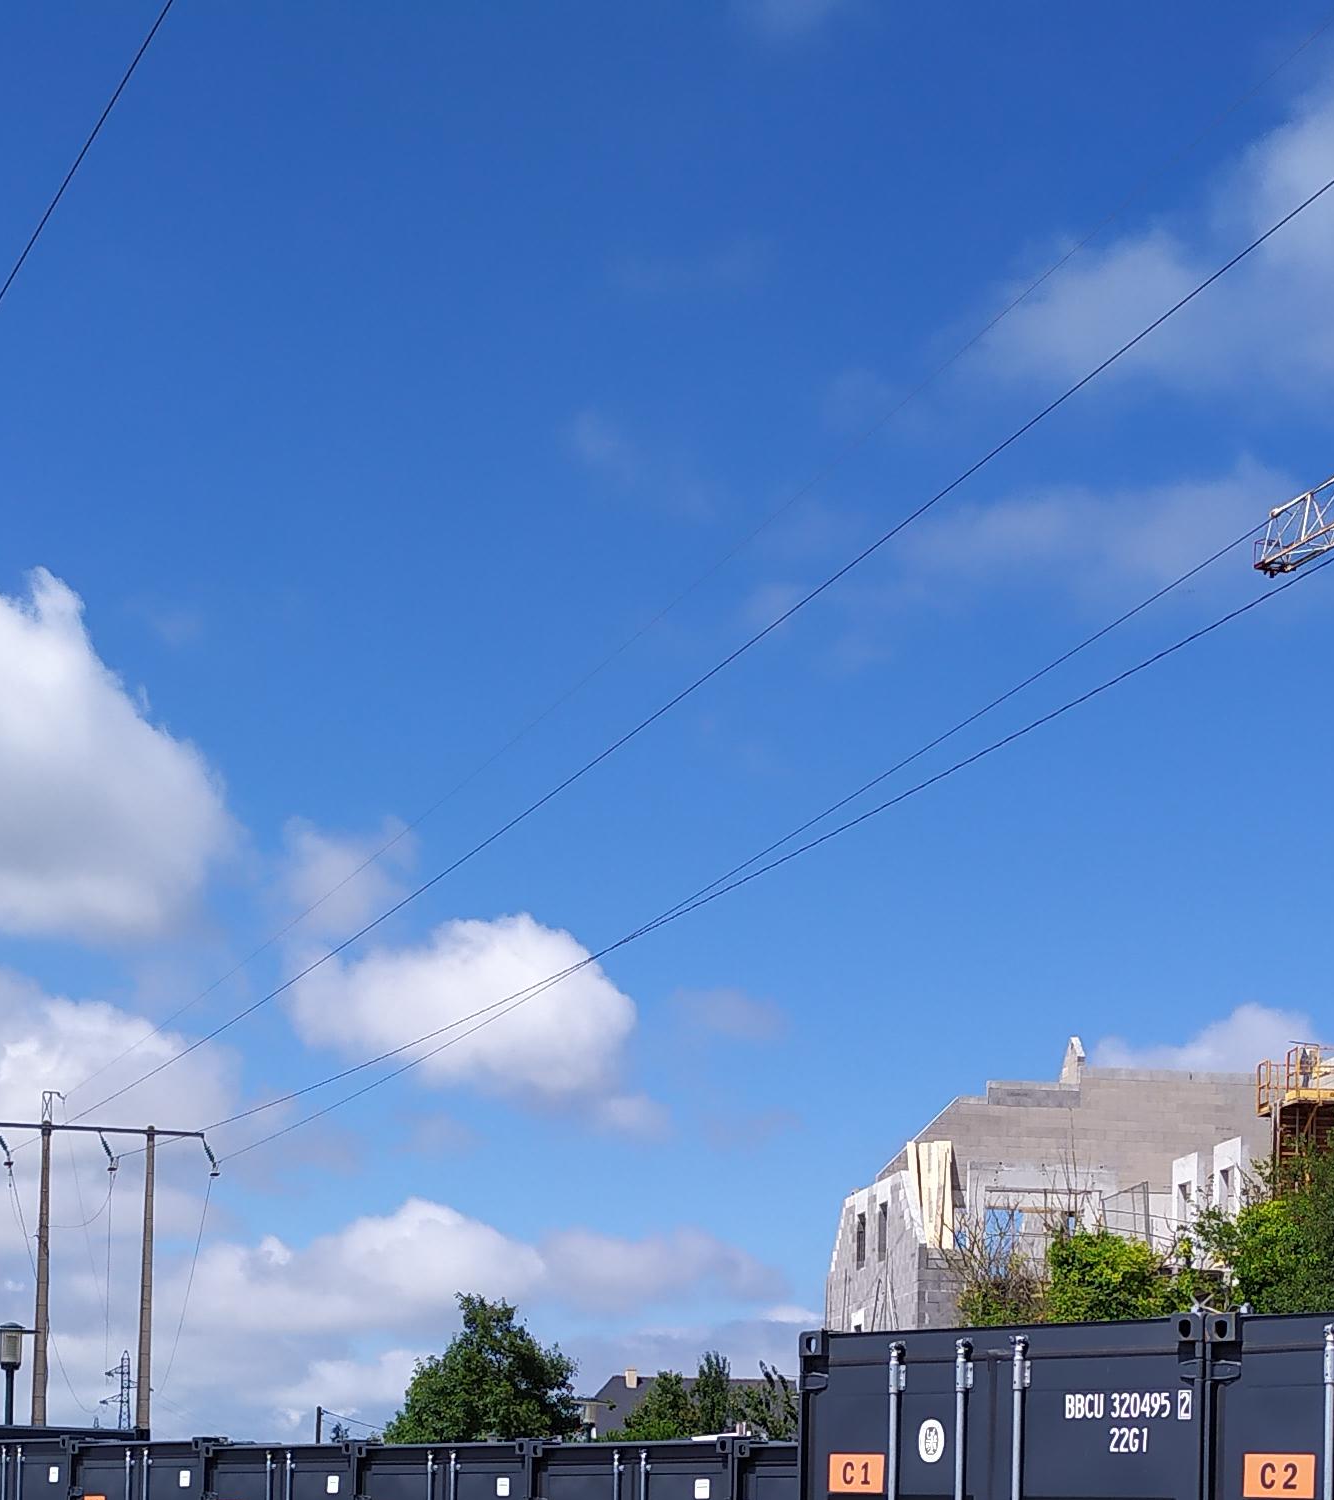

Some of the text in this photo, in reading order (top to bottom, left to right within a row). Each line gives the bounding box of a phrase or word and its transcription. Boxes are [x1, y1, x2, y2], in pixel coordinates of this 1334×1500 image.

[1064, 1391, 1191, 1419] BBCU 320495 2
[1109, 1427, 1148, 1453] 22G1
